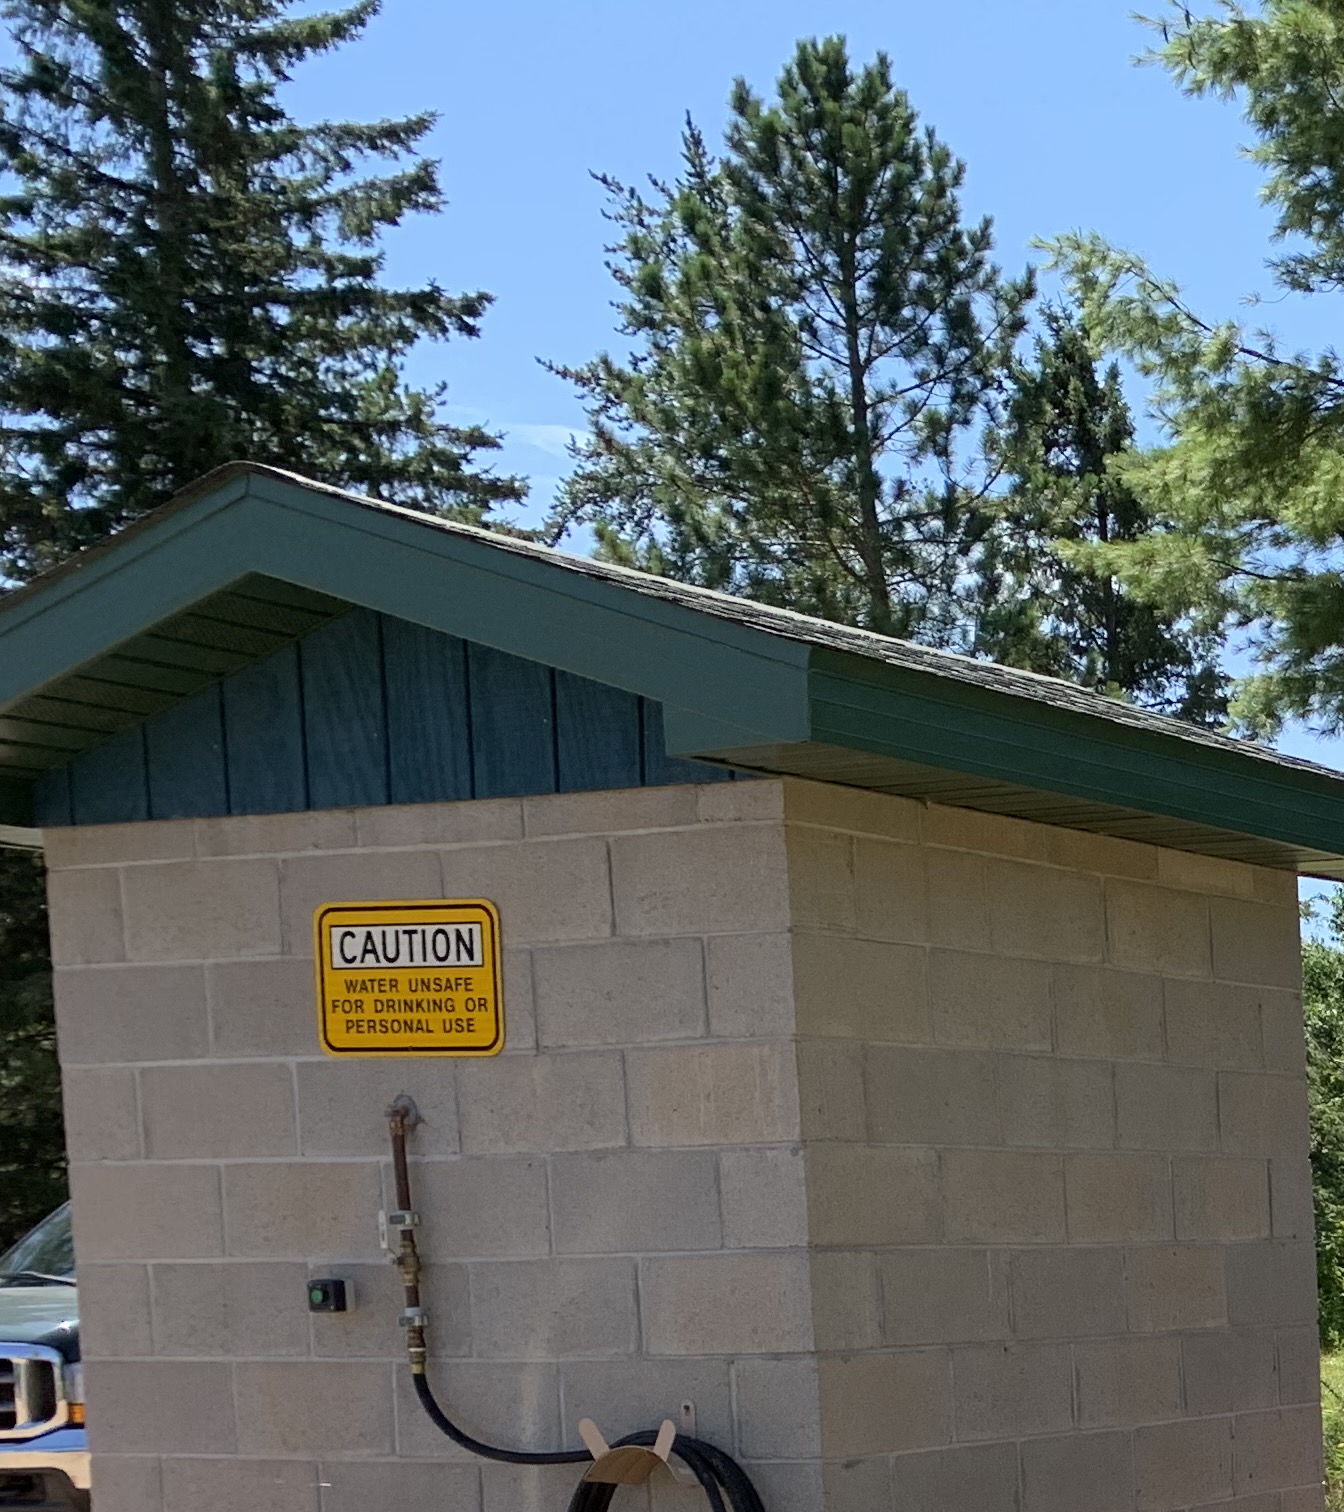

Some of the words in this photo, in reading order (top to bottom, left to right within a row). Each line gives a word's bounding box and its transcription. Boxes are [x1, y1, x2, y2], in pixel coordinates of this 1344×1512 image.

[339, 928, 474, 964] CAUTION
[344, 978, 400, 993] WATER
[408, 977, 474, 993] UNSAFE
[331, 999, 364, 1014] FOR
[374, 998, 456, 1014] DRINKING
[465, 997, 488, 1013] OR
[345, 1019, 434, 1034] PERSONAL
[443, 1018, 477, 1033] USE
